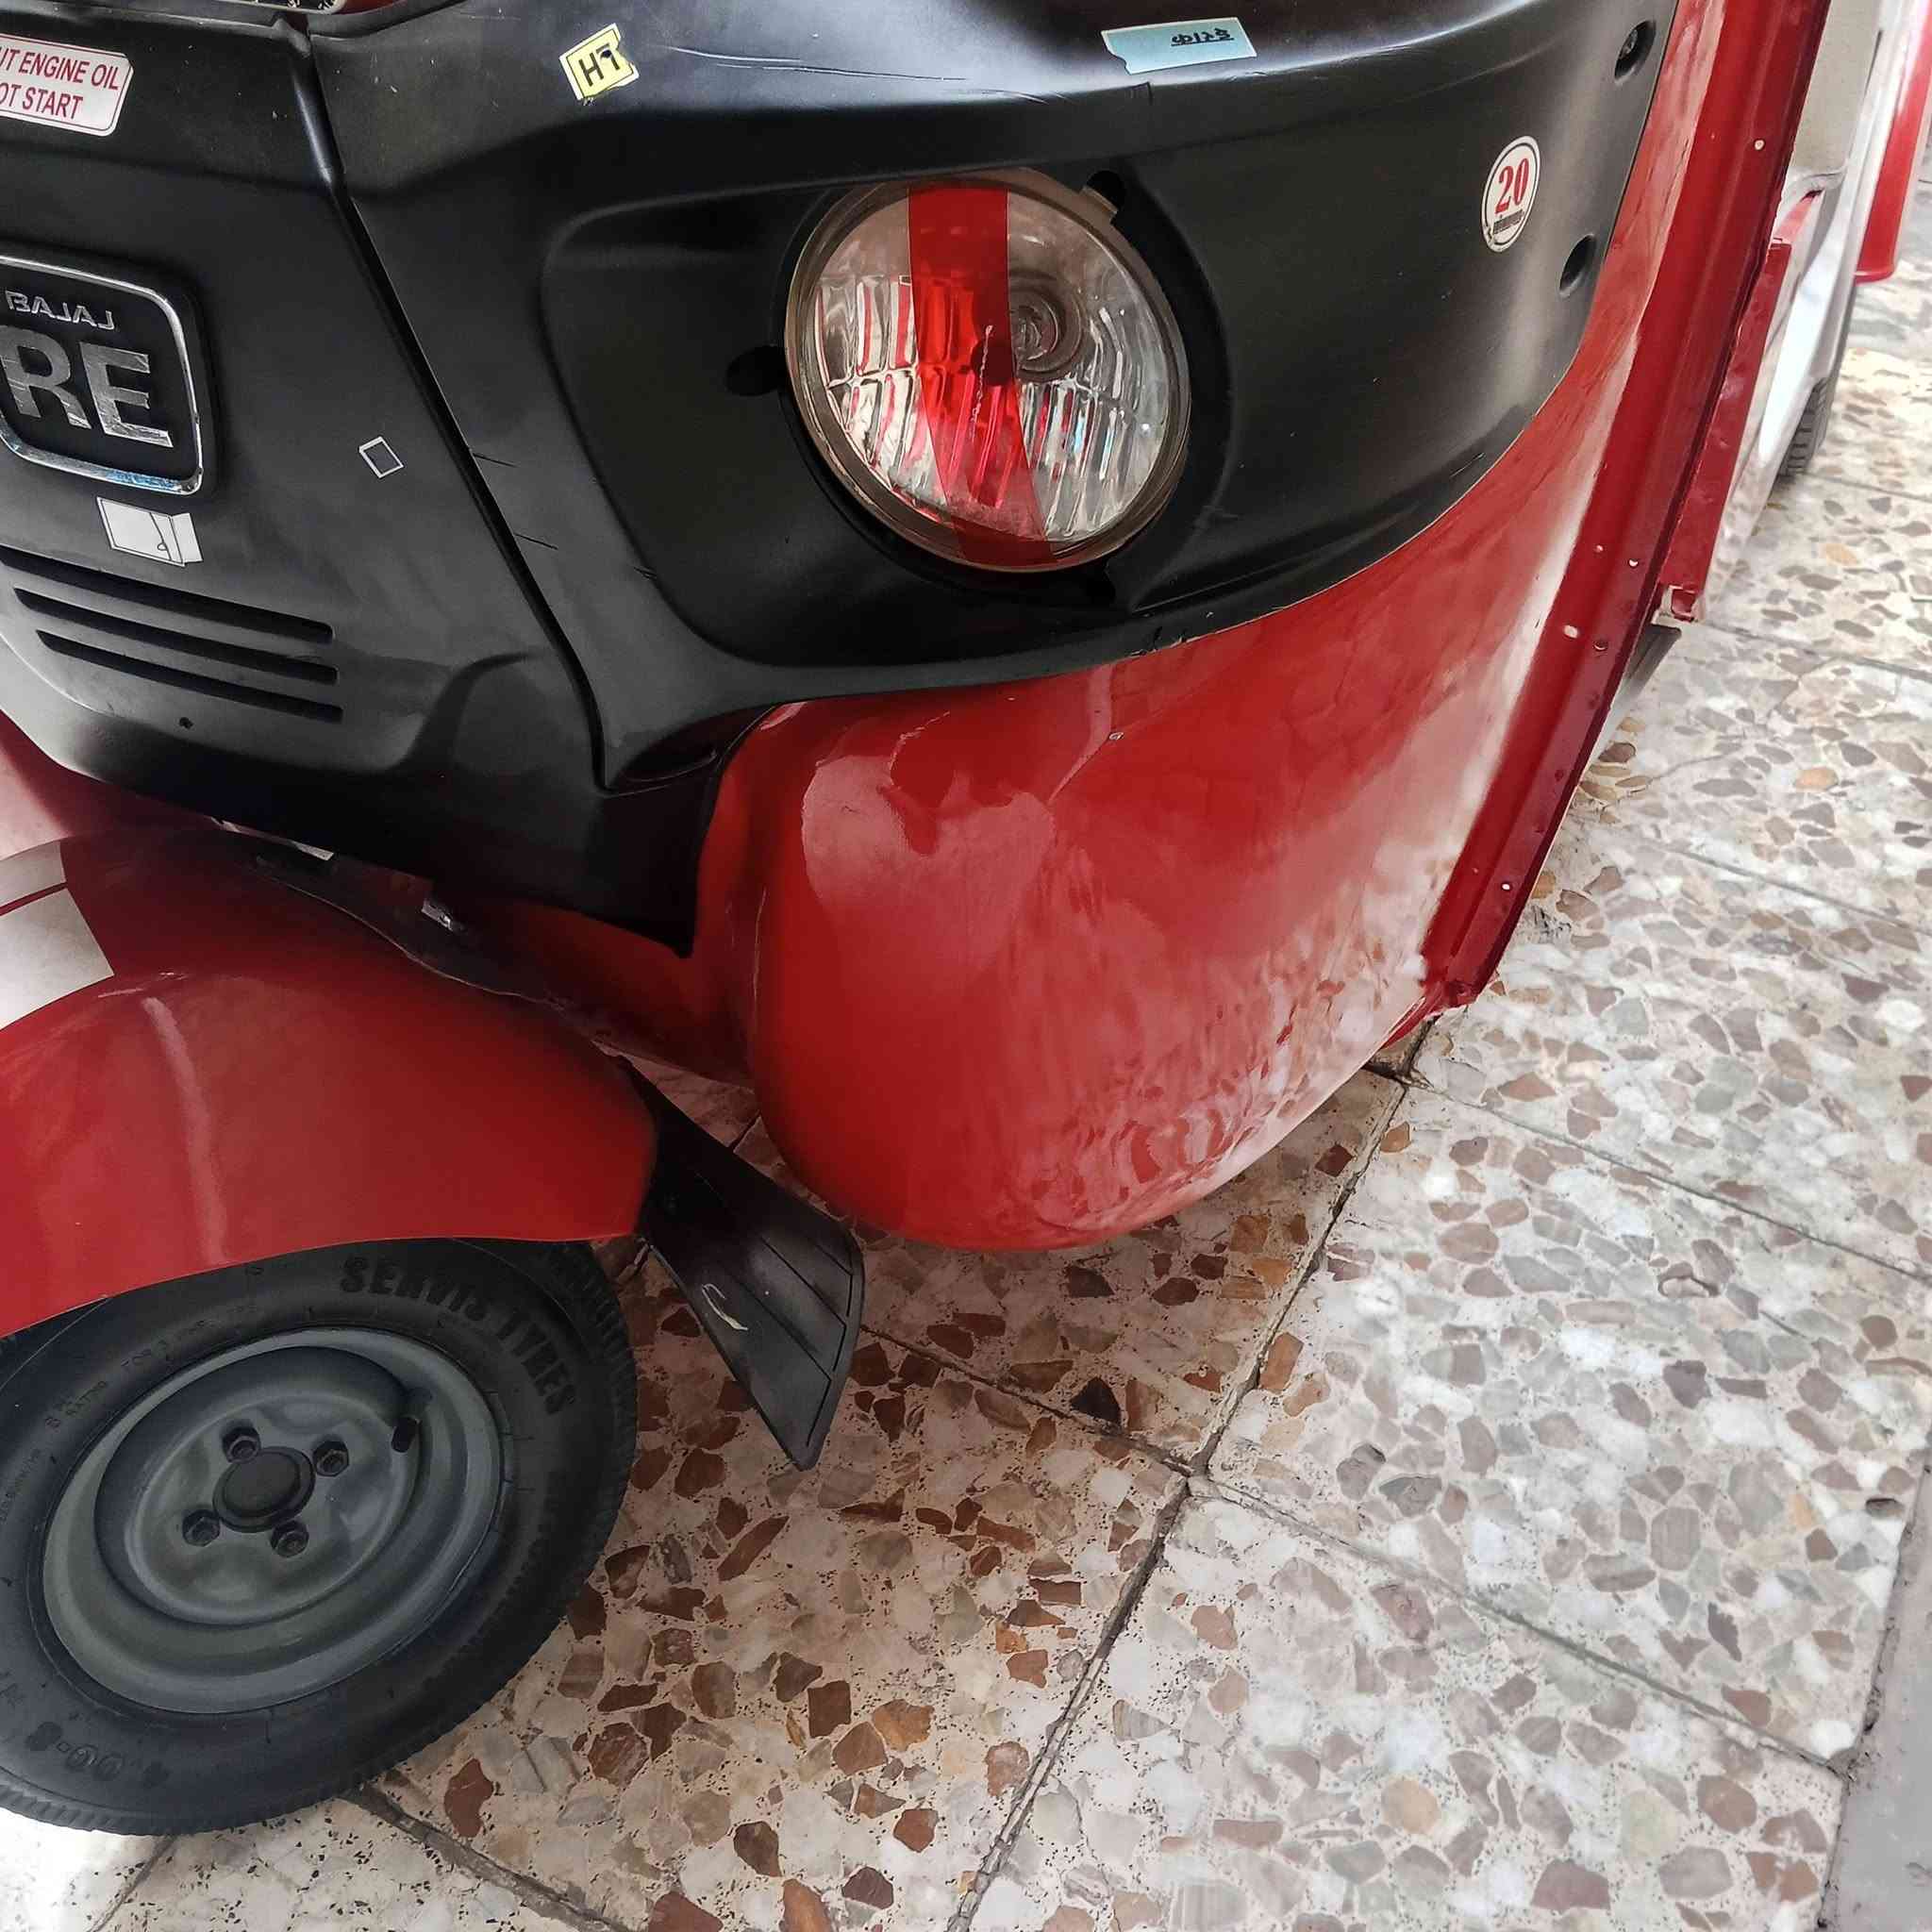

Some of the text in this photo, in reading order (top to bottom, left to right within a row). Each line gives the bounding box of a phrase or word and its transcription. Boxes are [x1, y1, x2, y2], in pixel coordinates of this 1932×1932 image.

[19, 51, 90, 84] ENGINE
[91, 63, 119, 91] OIL
[23, 86, 83, 120] START
[1494, 158, 1529, 215] 20
[5, 290, 116, 331] BAJAJ
[0, 324, 174, 448] RE
